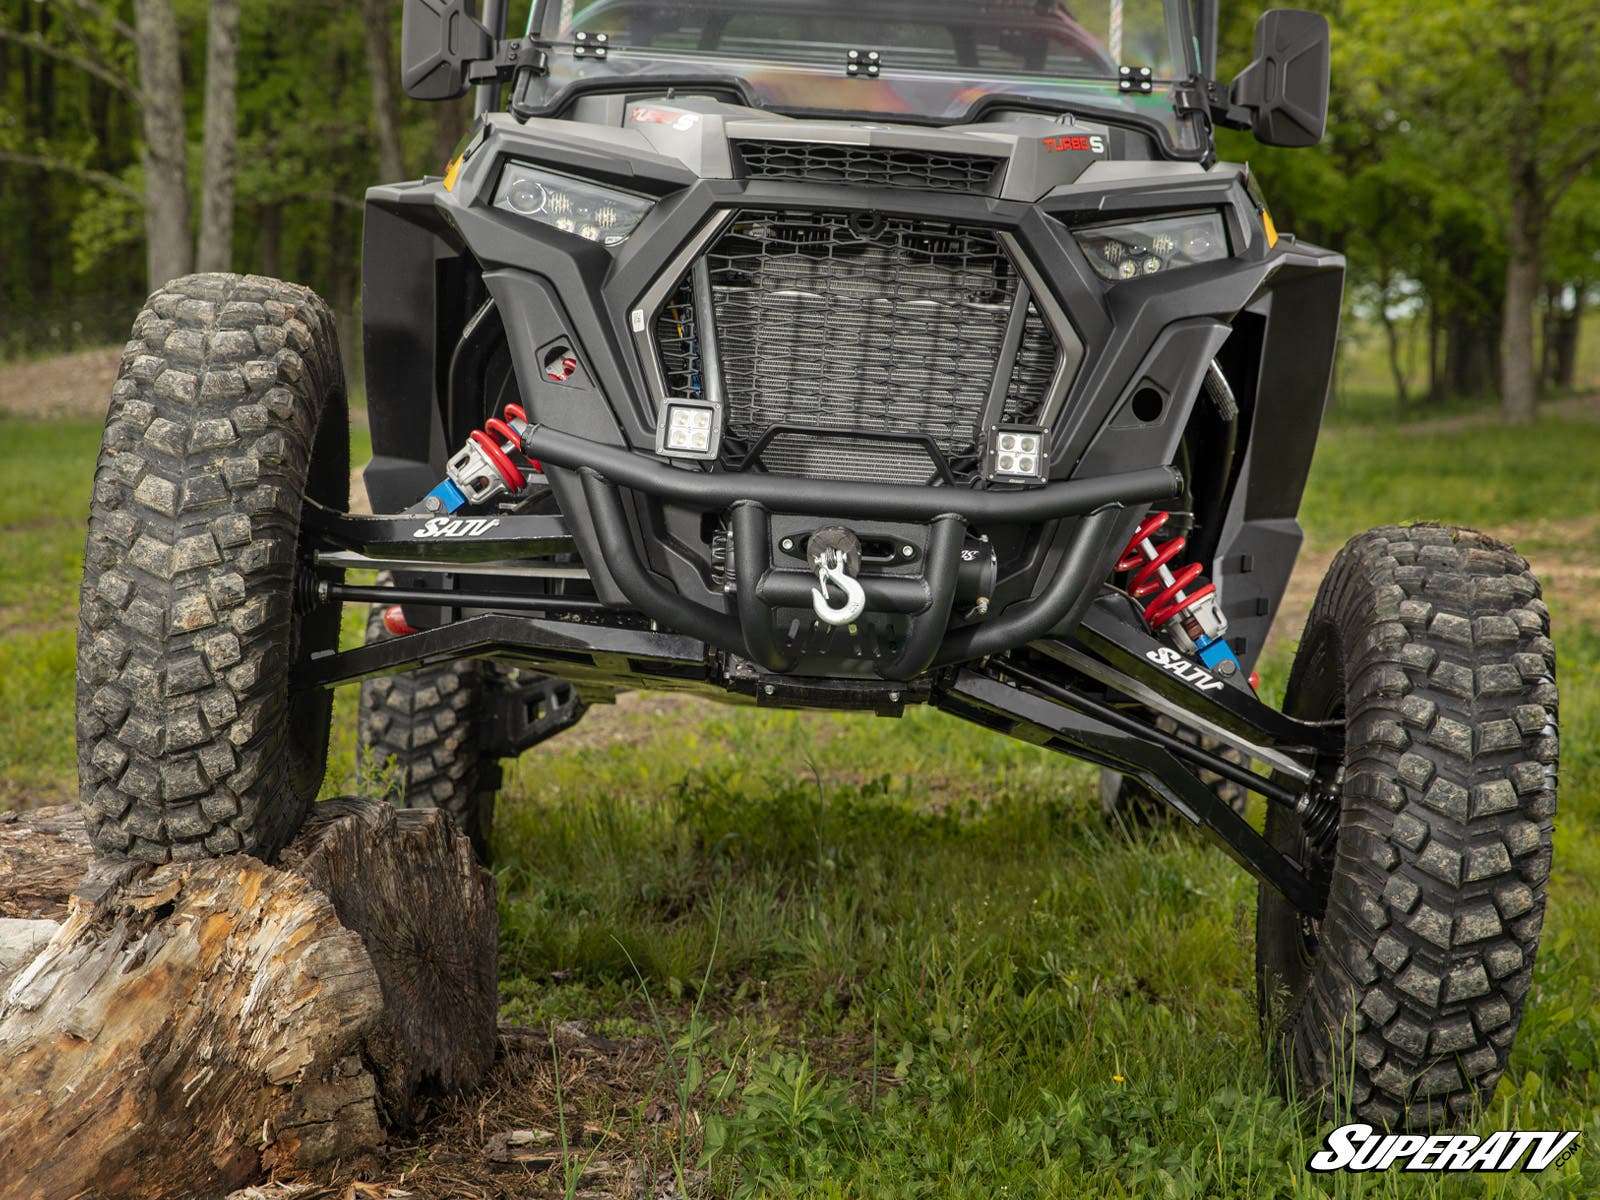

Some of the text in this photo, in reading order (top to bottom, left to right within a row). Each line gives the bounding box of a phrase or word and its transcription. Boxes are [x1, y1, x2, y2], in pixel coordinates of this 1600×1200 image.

[1089, 135, 1105, 154] S
[413, 516, 500, 538] SATV
[1146, 647, 1225, 691] SATV
